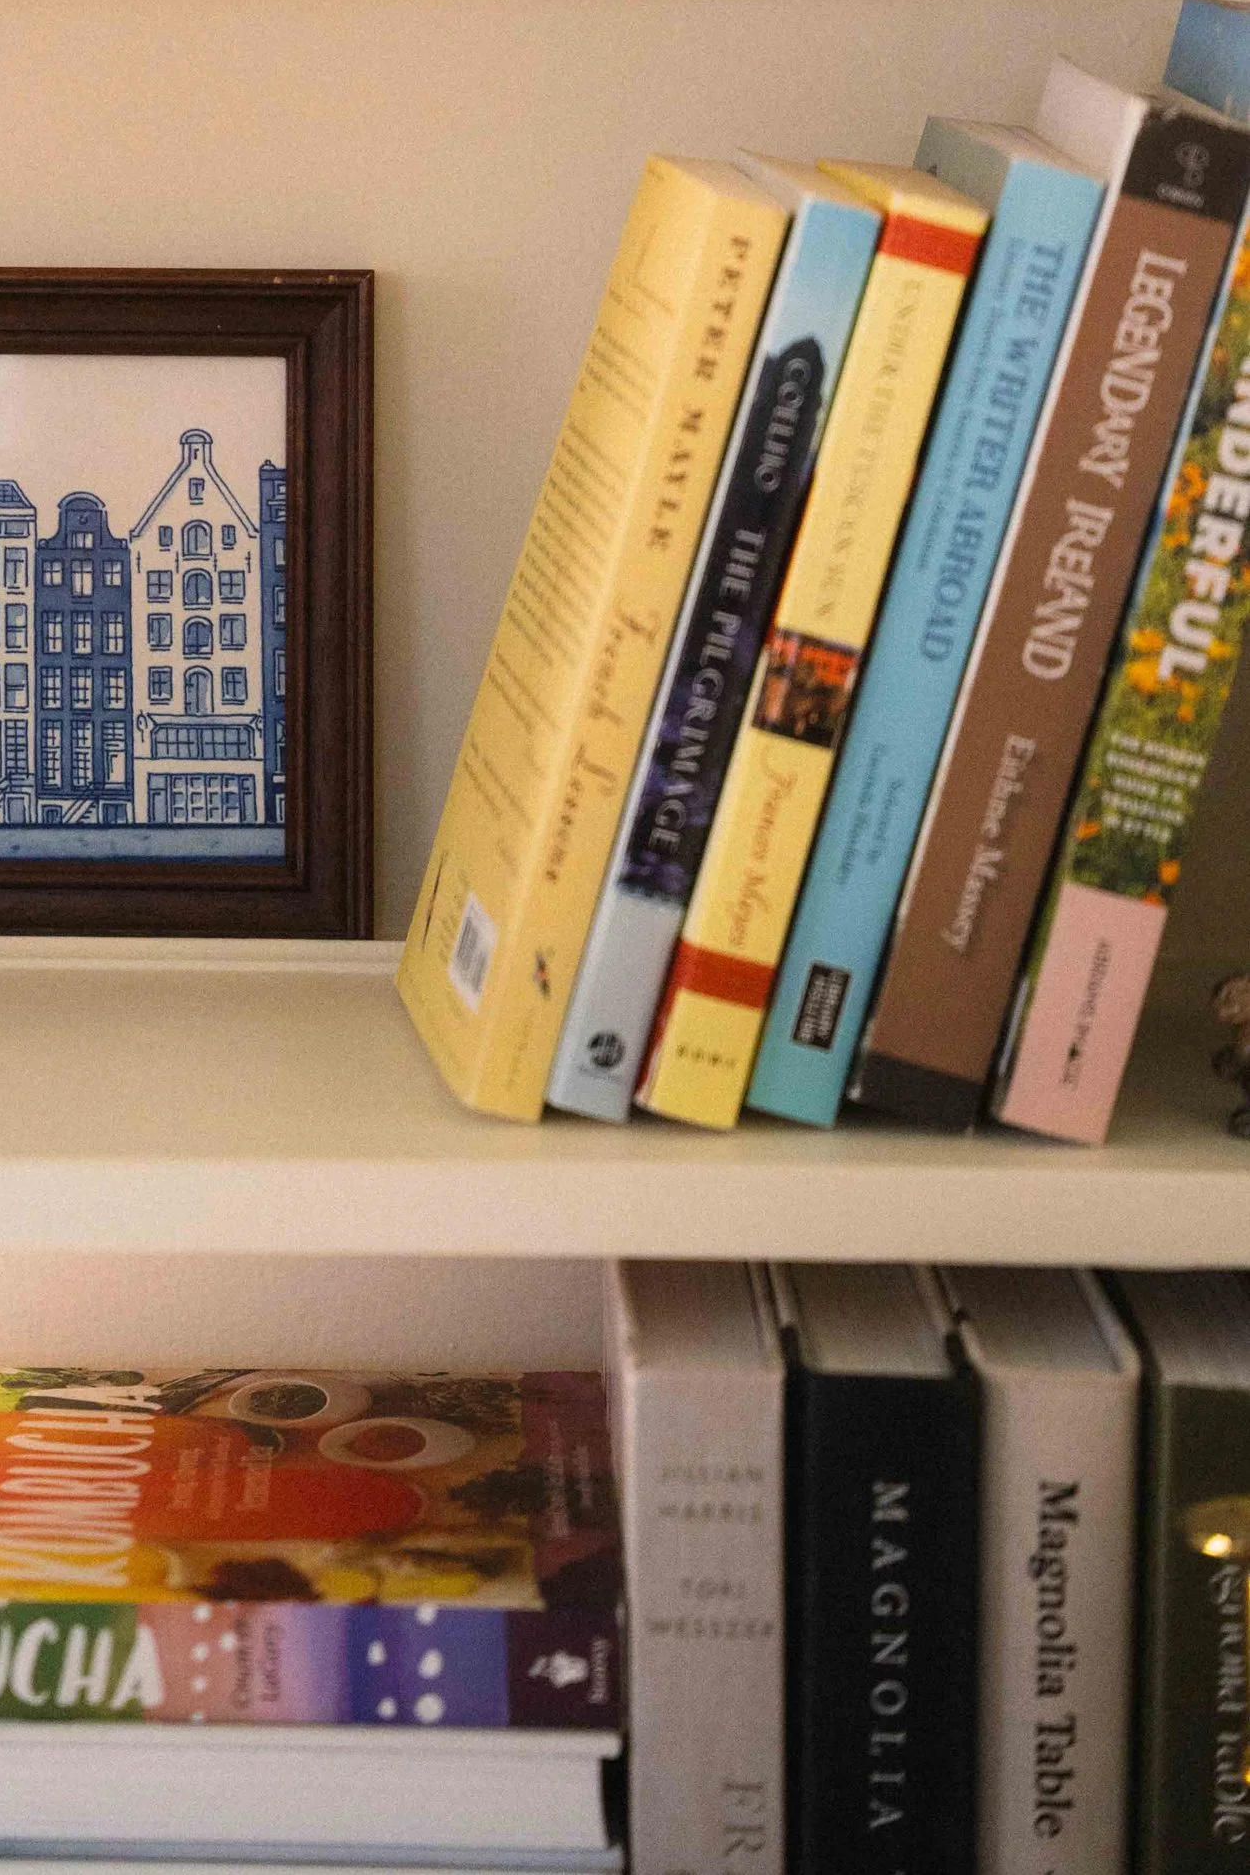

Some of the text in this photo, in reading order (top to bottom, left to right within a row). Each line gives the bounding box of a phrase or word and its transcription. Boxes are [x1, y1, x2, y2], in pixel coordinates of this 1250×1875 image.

[648, 235, 751, 552] PETER MAYLE
[1020, 238, 1067, 323] THE
[1079, 249, 1188, 489] LEGENDARY
[966, 330, 1042, 494] WRITER
[1157, 357, 1250, 682] NDERFUL
[719, 526, 767, 599] THE
[921, 499, 988, 662] ABROAD
[1020, 496, 1114, 680] IRELAND
[649, 612, 752, 856] PILGRIMAGE
[869, 1479, 911, 1830] MAGNOLIA
[1027, 1479, 1080, 1841] Magnolia Table
